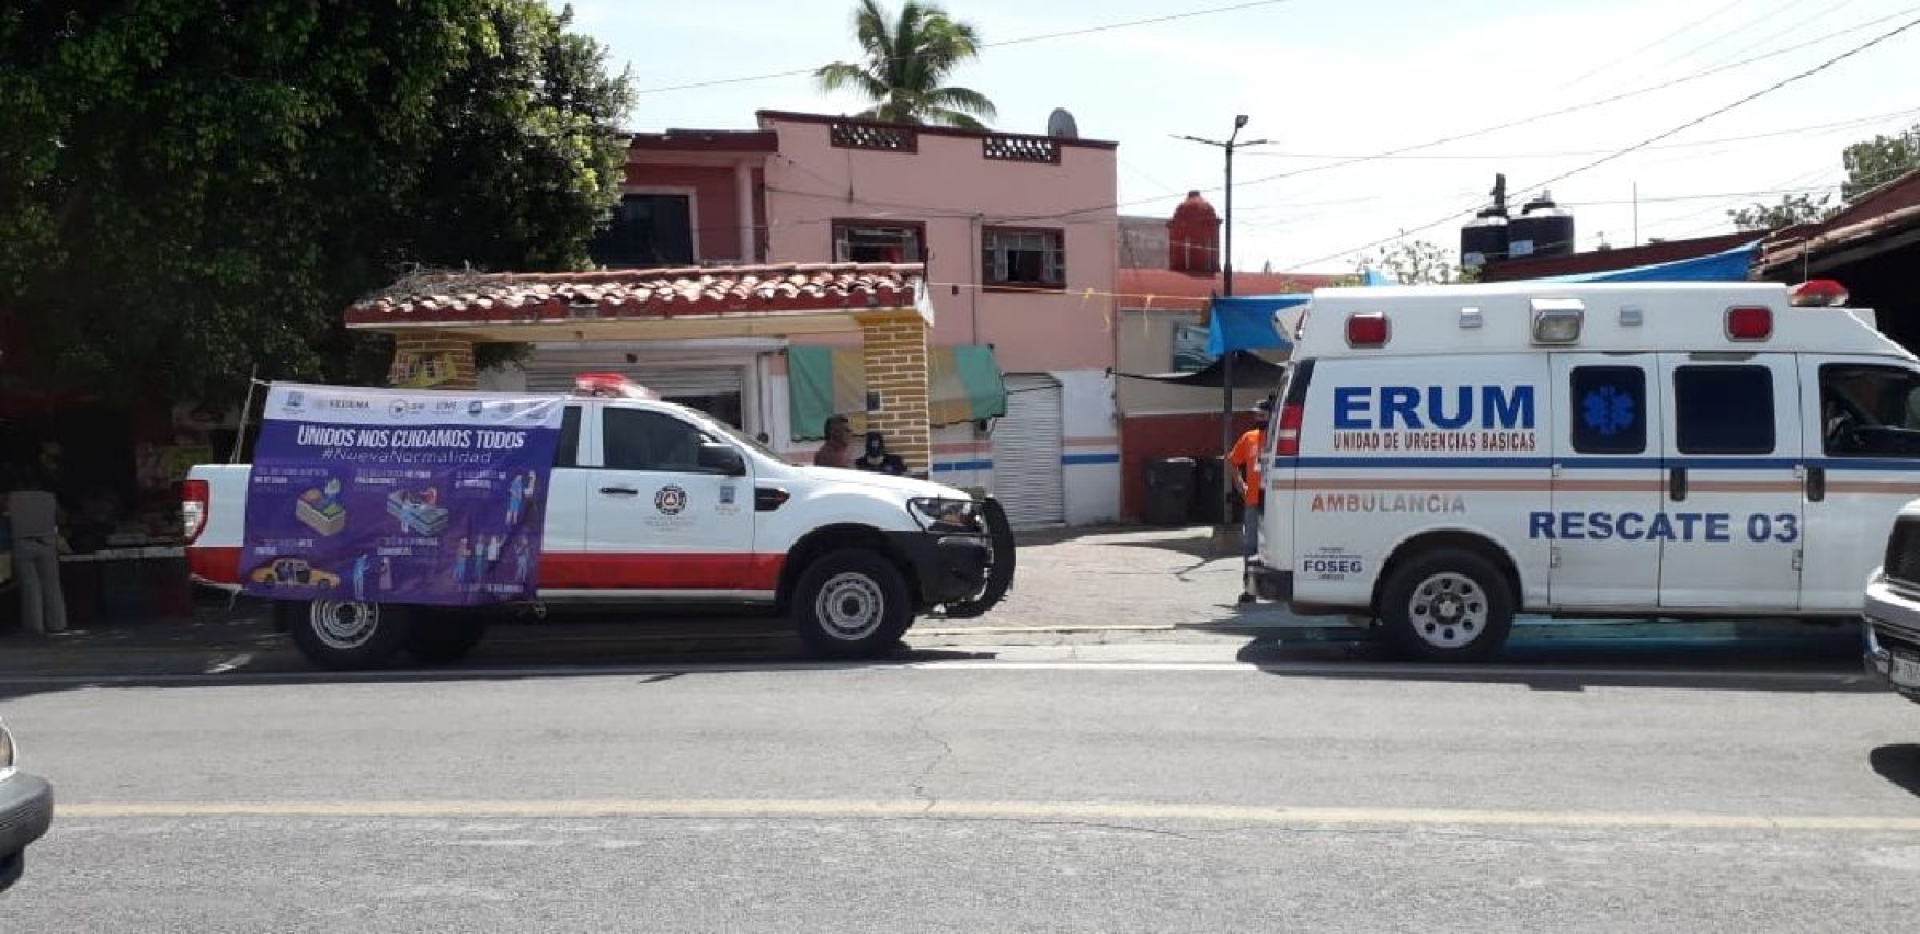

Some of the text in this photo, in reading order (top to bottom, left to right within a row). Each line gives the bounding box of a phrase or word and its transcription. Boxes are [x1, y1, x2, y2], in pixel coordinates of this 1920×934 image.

[1334, 386, 1535, 430] ERUM
[297, 425, 526, 449] UNIDOS NOS CUIDAMOS TODOS
[1334, 432, 1536, 450] UNIDAD DE URGENCIAS BASICAS
[321, 447, 491, 463] #NuevaNormalidad
[1310, 493, 1466, 513] AMBULANCIA
[1529, 511, 1799, 543] RESCATE 03
[1303, 560, 1363, 573] FOSEG
